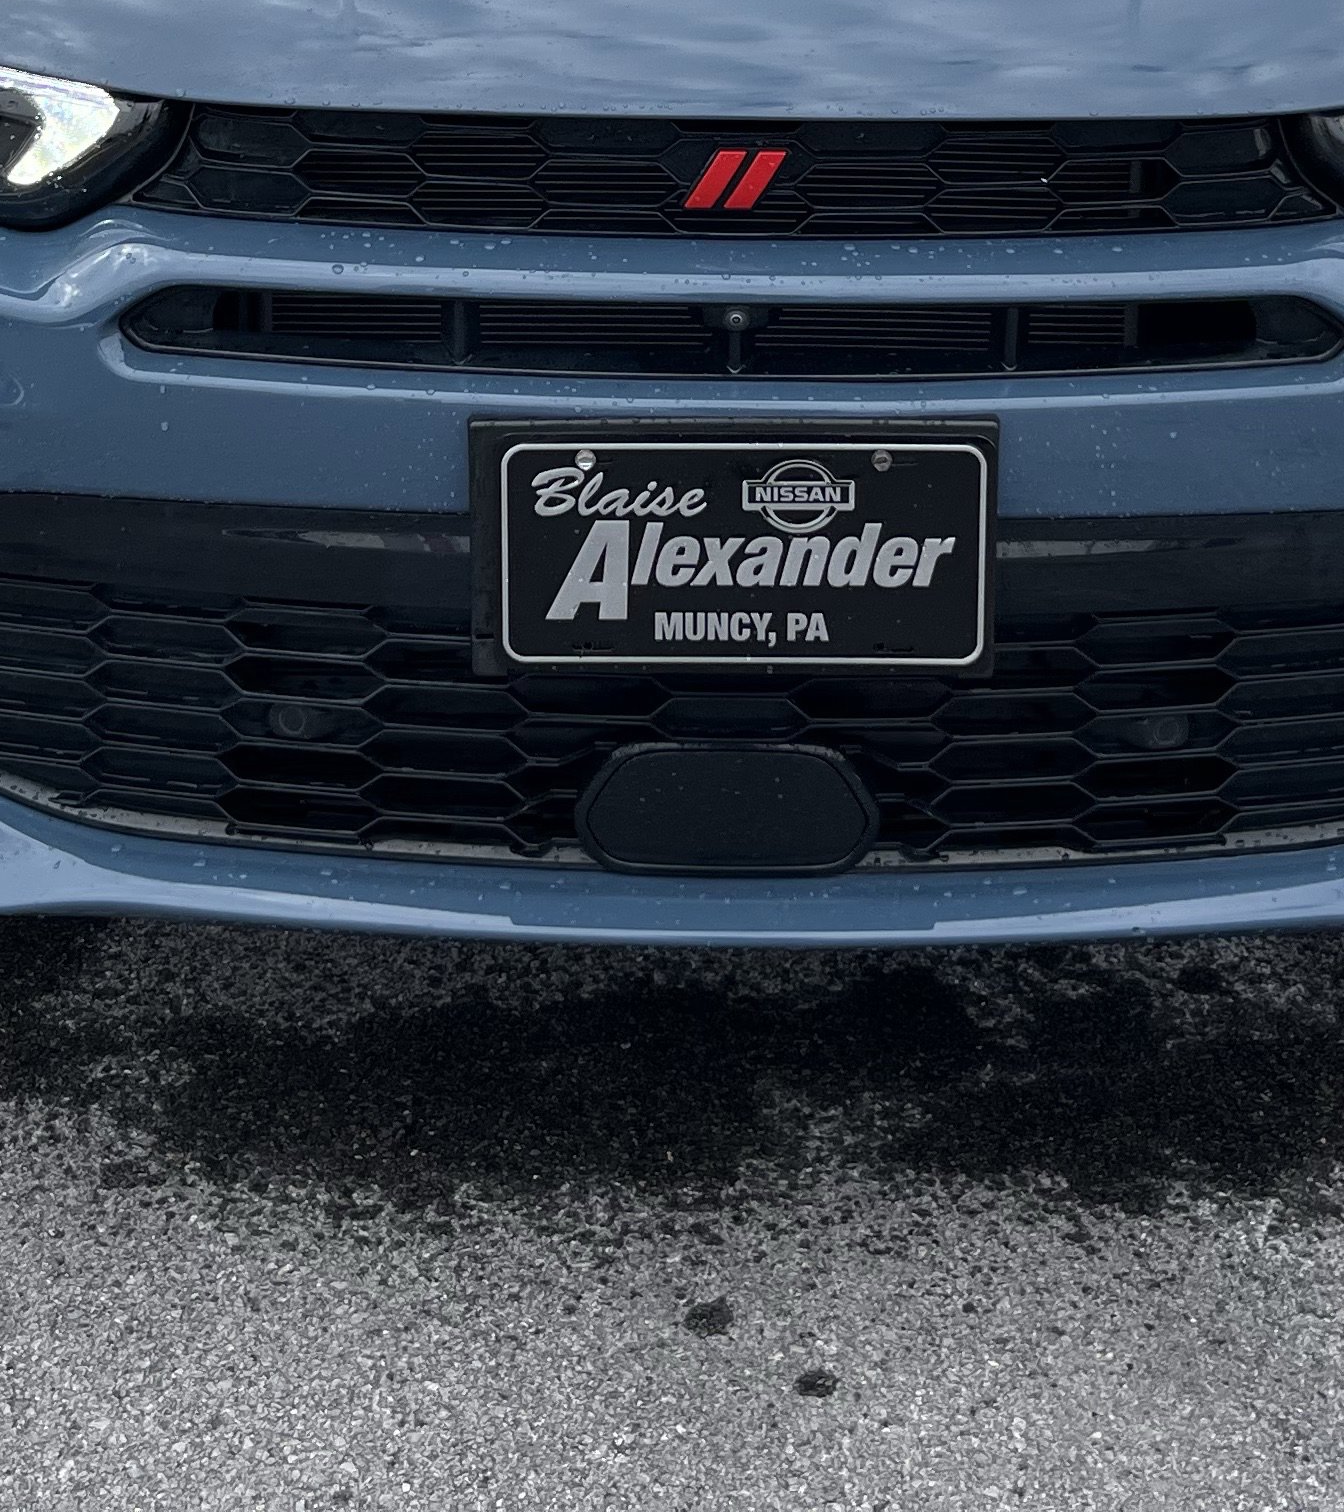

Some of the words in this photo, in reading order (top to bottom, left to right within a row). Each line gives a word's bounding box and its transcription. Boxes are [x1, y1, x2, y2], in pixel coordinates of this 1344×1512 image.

[531, 466, 708, 518] Blaise
[754, 485, 842, 504] NISSAN
[545, 519, 957, 621] Alexander
[654, 611, 778, 648] MUNCY,
[786, 612, 830, 642] PA
